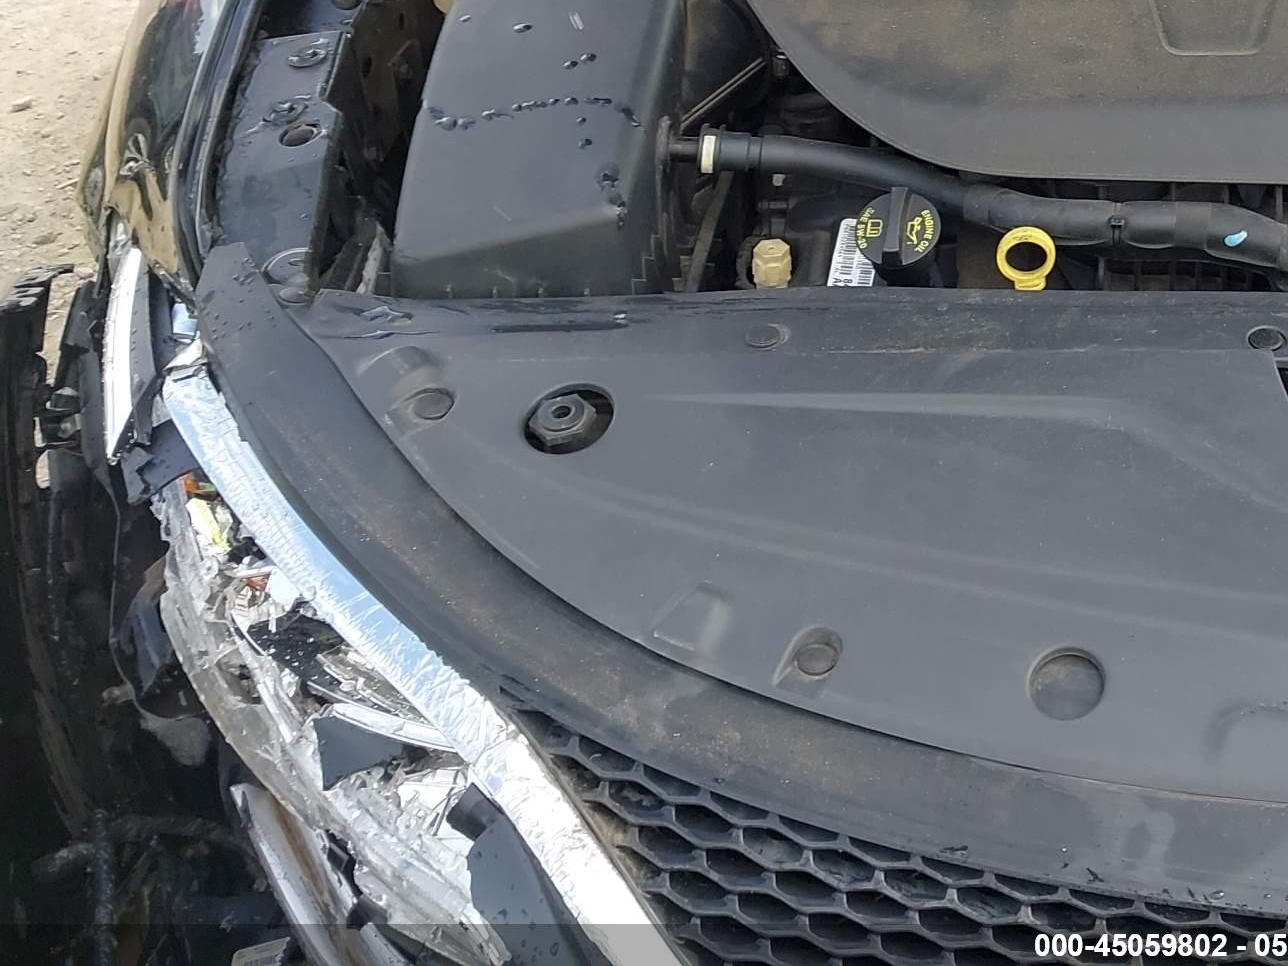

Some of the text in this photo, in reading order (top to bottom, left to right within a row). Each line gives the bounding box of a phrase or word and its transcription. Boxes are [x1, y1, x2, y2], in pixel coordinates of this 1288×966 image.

[856, 207, 875, 249] SAE 5W-20
[913, 210, 935, 253] ENGINE OIL
